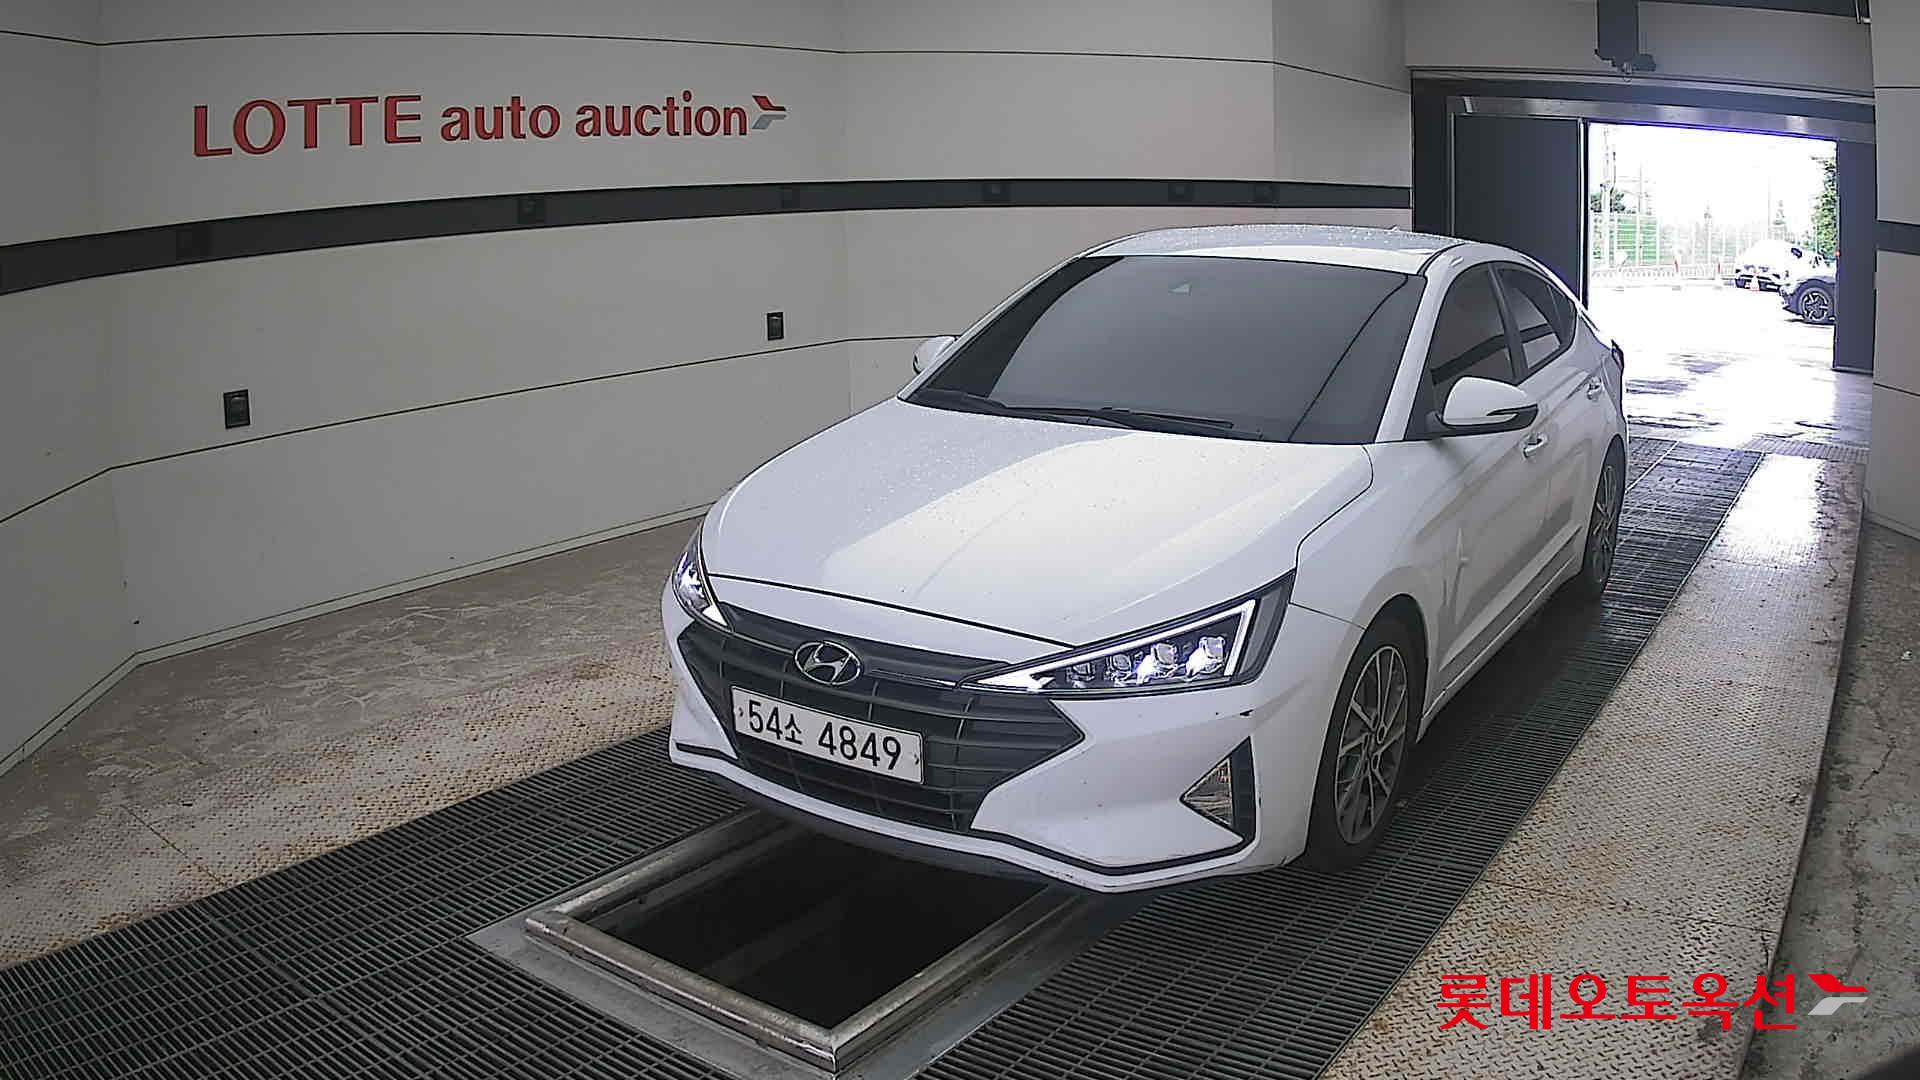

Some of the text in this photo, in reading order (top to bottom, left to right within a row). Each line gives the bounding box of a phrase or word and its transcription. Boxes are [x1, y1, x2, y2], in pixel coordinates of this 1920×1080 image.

[193, 90, 749, 157] LOTTE auto auction
[748, 699, 902, 770] 54소 4849
